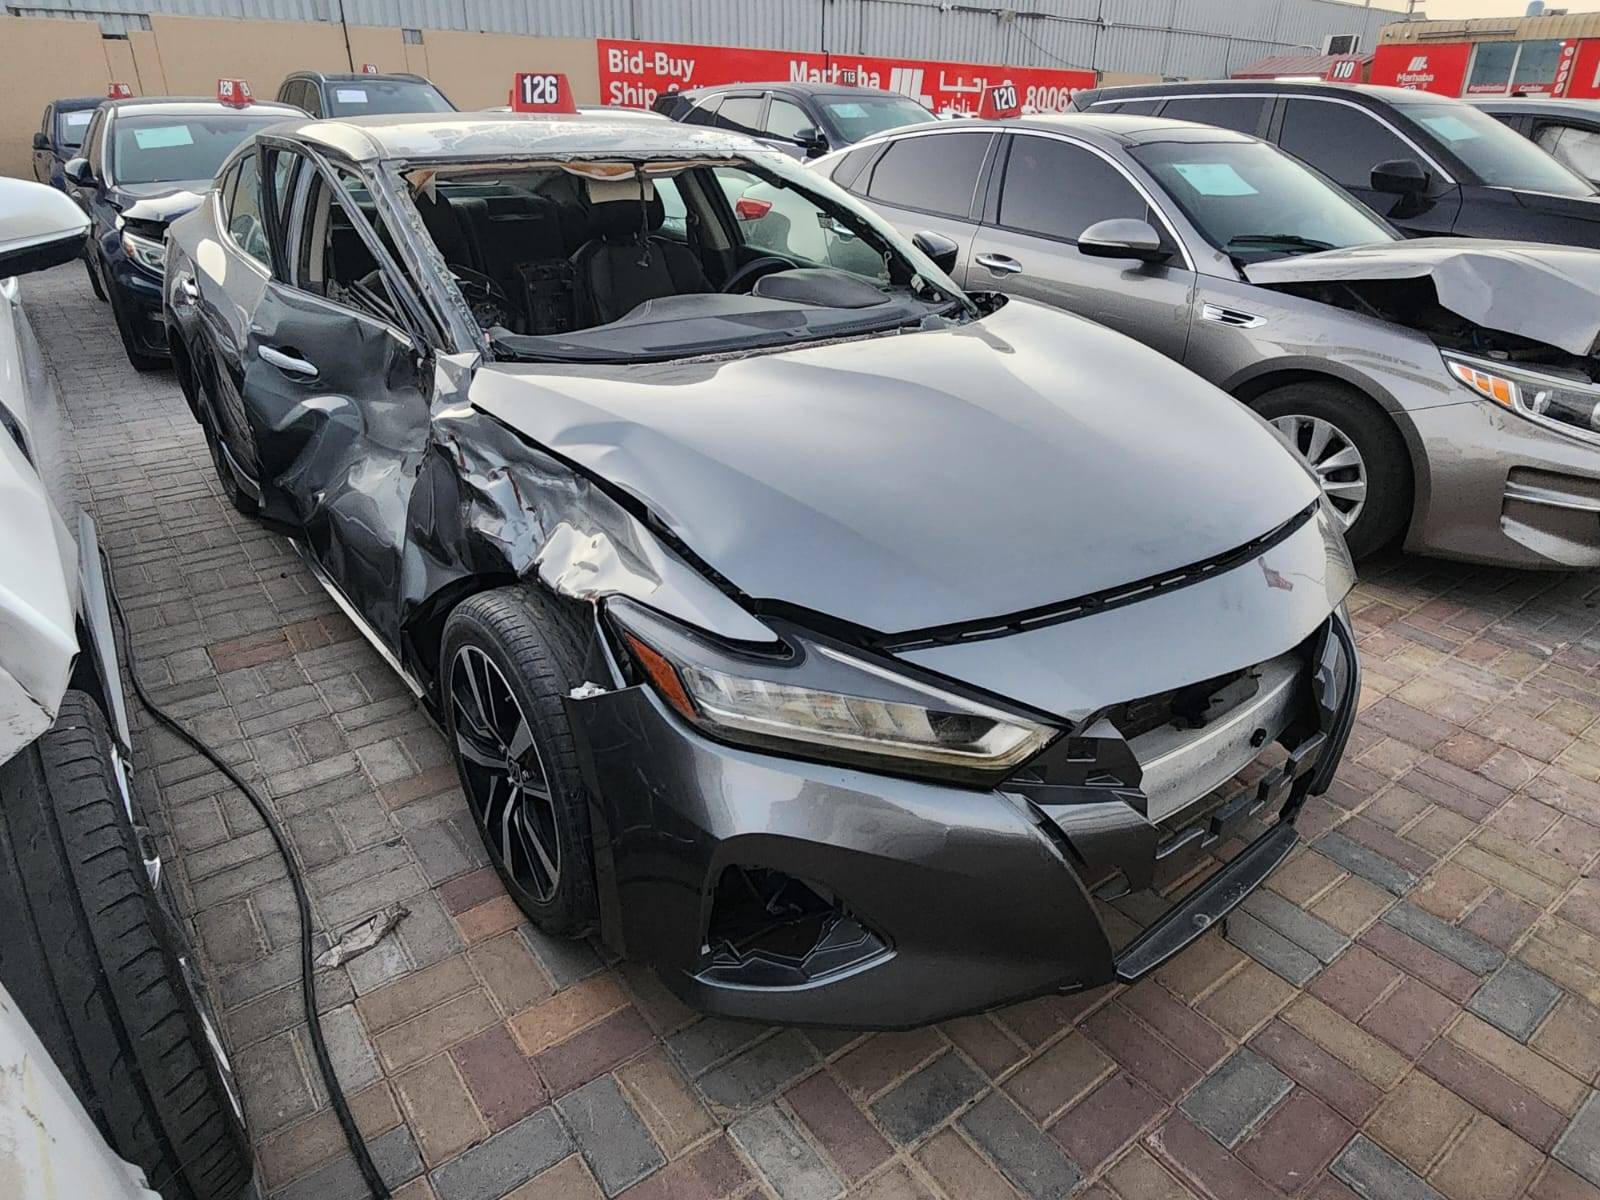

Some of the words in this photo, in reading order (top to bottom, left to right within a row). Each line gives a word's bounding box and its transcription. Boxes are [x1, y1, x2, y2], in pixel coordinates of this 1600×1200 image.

[608, 48, 695, 82] Bid-Buy
[789, 60, 881, 89] Marhba
[1333, 60, 1355, 78] 110
[523, 74, 558, 104] 126
[609, 80, 657, 111] Ship
[993, 86, 1017, 111] 120
[1025, 85, 1088, 113] 8006
